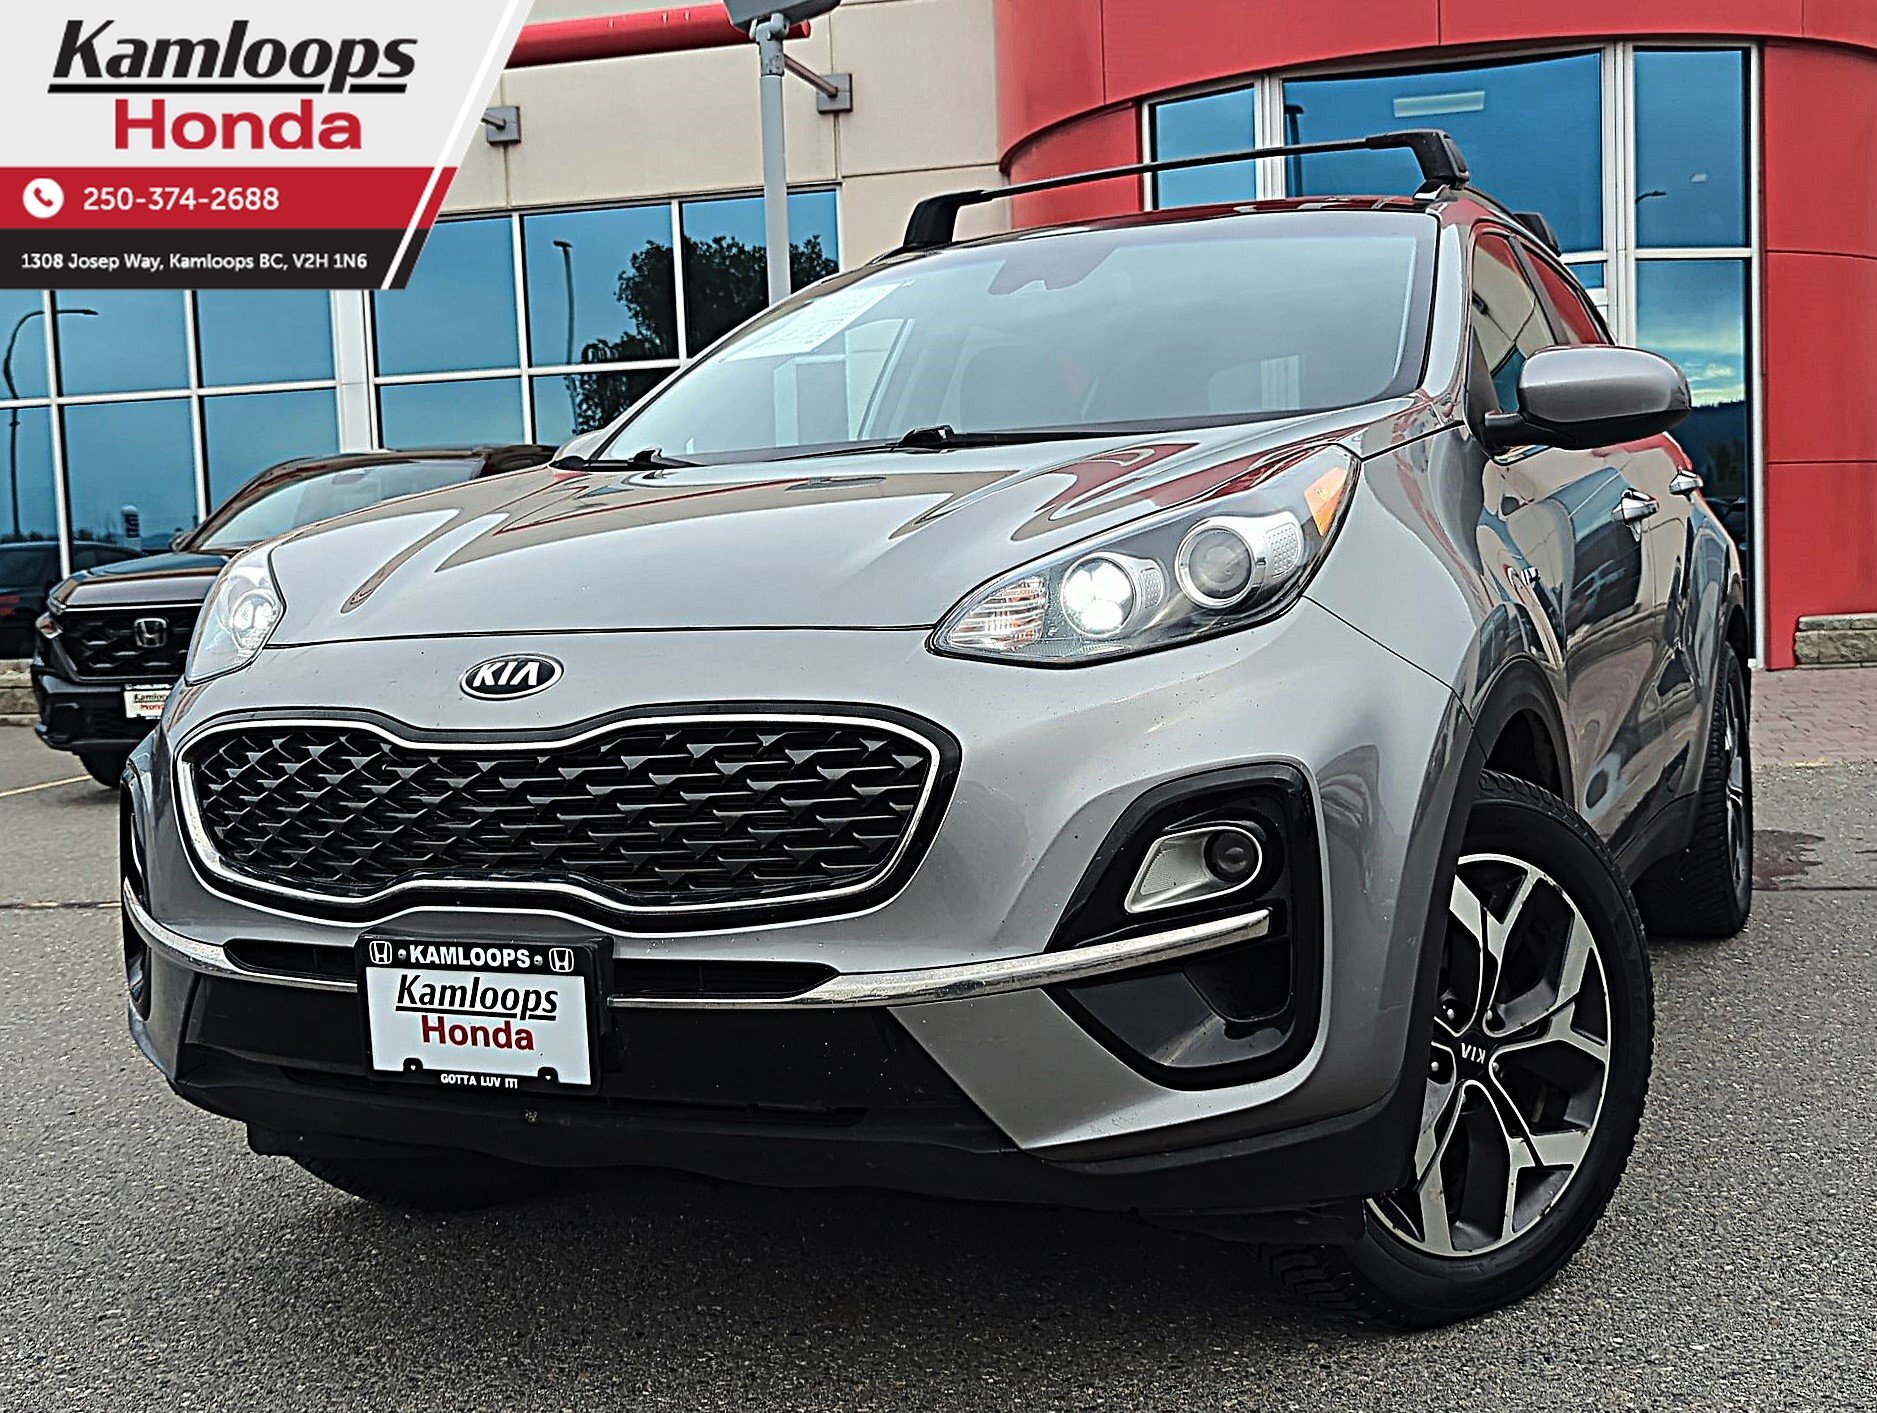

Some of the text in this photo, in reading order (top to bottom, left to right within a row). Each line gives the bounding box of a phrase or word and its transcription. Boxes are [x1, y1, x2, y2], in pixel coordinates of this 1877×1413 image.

[472, 661, 540, 687] KIA
[409, 944, 531, 968] KAMLOOPS
[396, 973, 559, 1021] Kamloops
[421, 1014, 535, 1051] Honda
[1460, 1043, 1487, 1065] KIA
[440, 1073, 478, 1086] GOTTA
[480, 1075, 502, 1088] LUV
